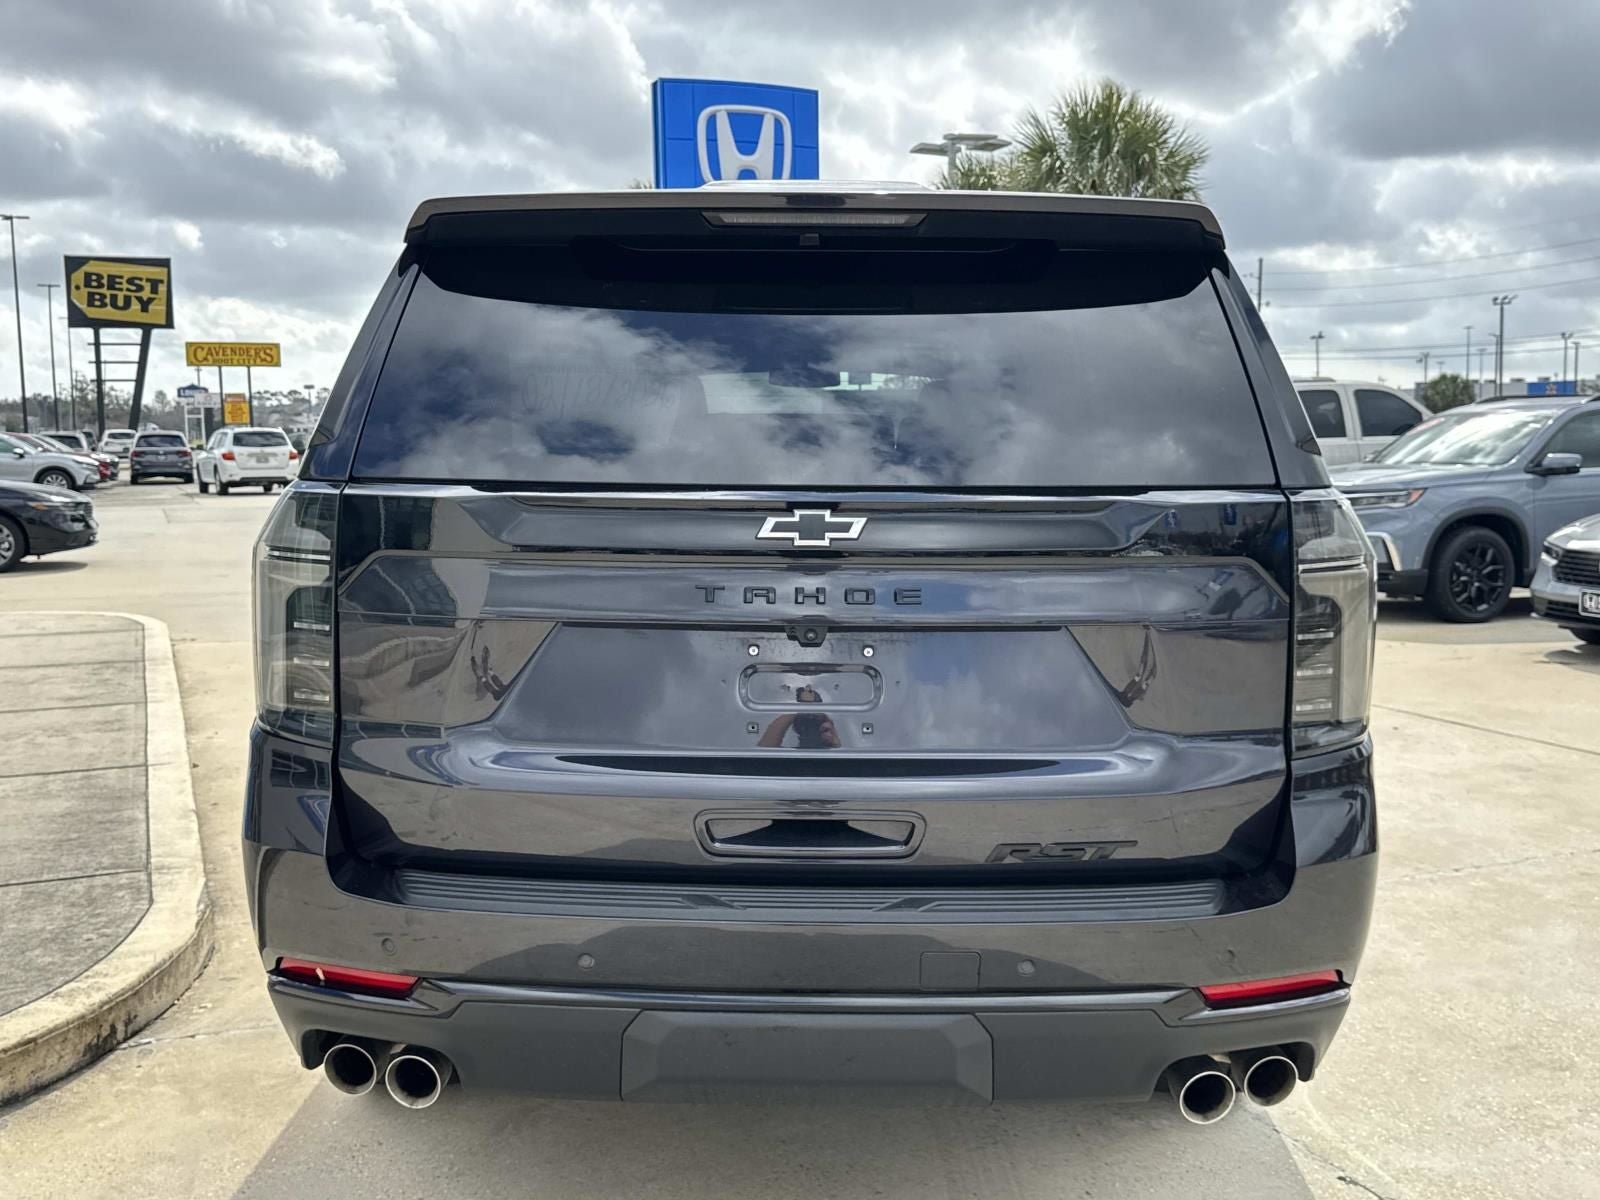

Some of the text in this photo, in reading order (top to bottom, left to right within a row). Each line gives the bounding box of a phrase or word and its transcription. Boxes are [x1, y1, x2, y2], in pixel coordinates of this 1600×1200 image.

[83, 271, 165, 295] BEST
[86, 291, 157, 314] BUY
[193, 345, 275, 364] CAVENDER'S
[695, 584, 923, 606] TAHOE
[984, 840, 1139, 864] RST
